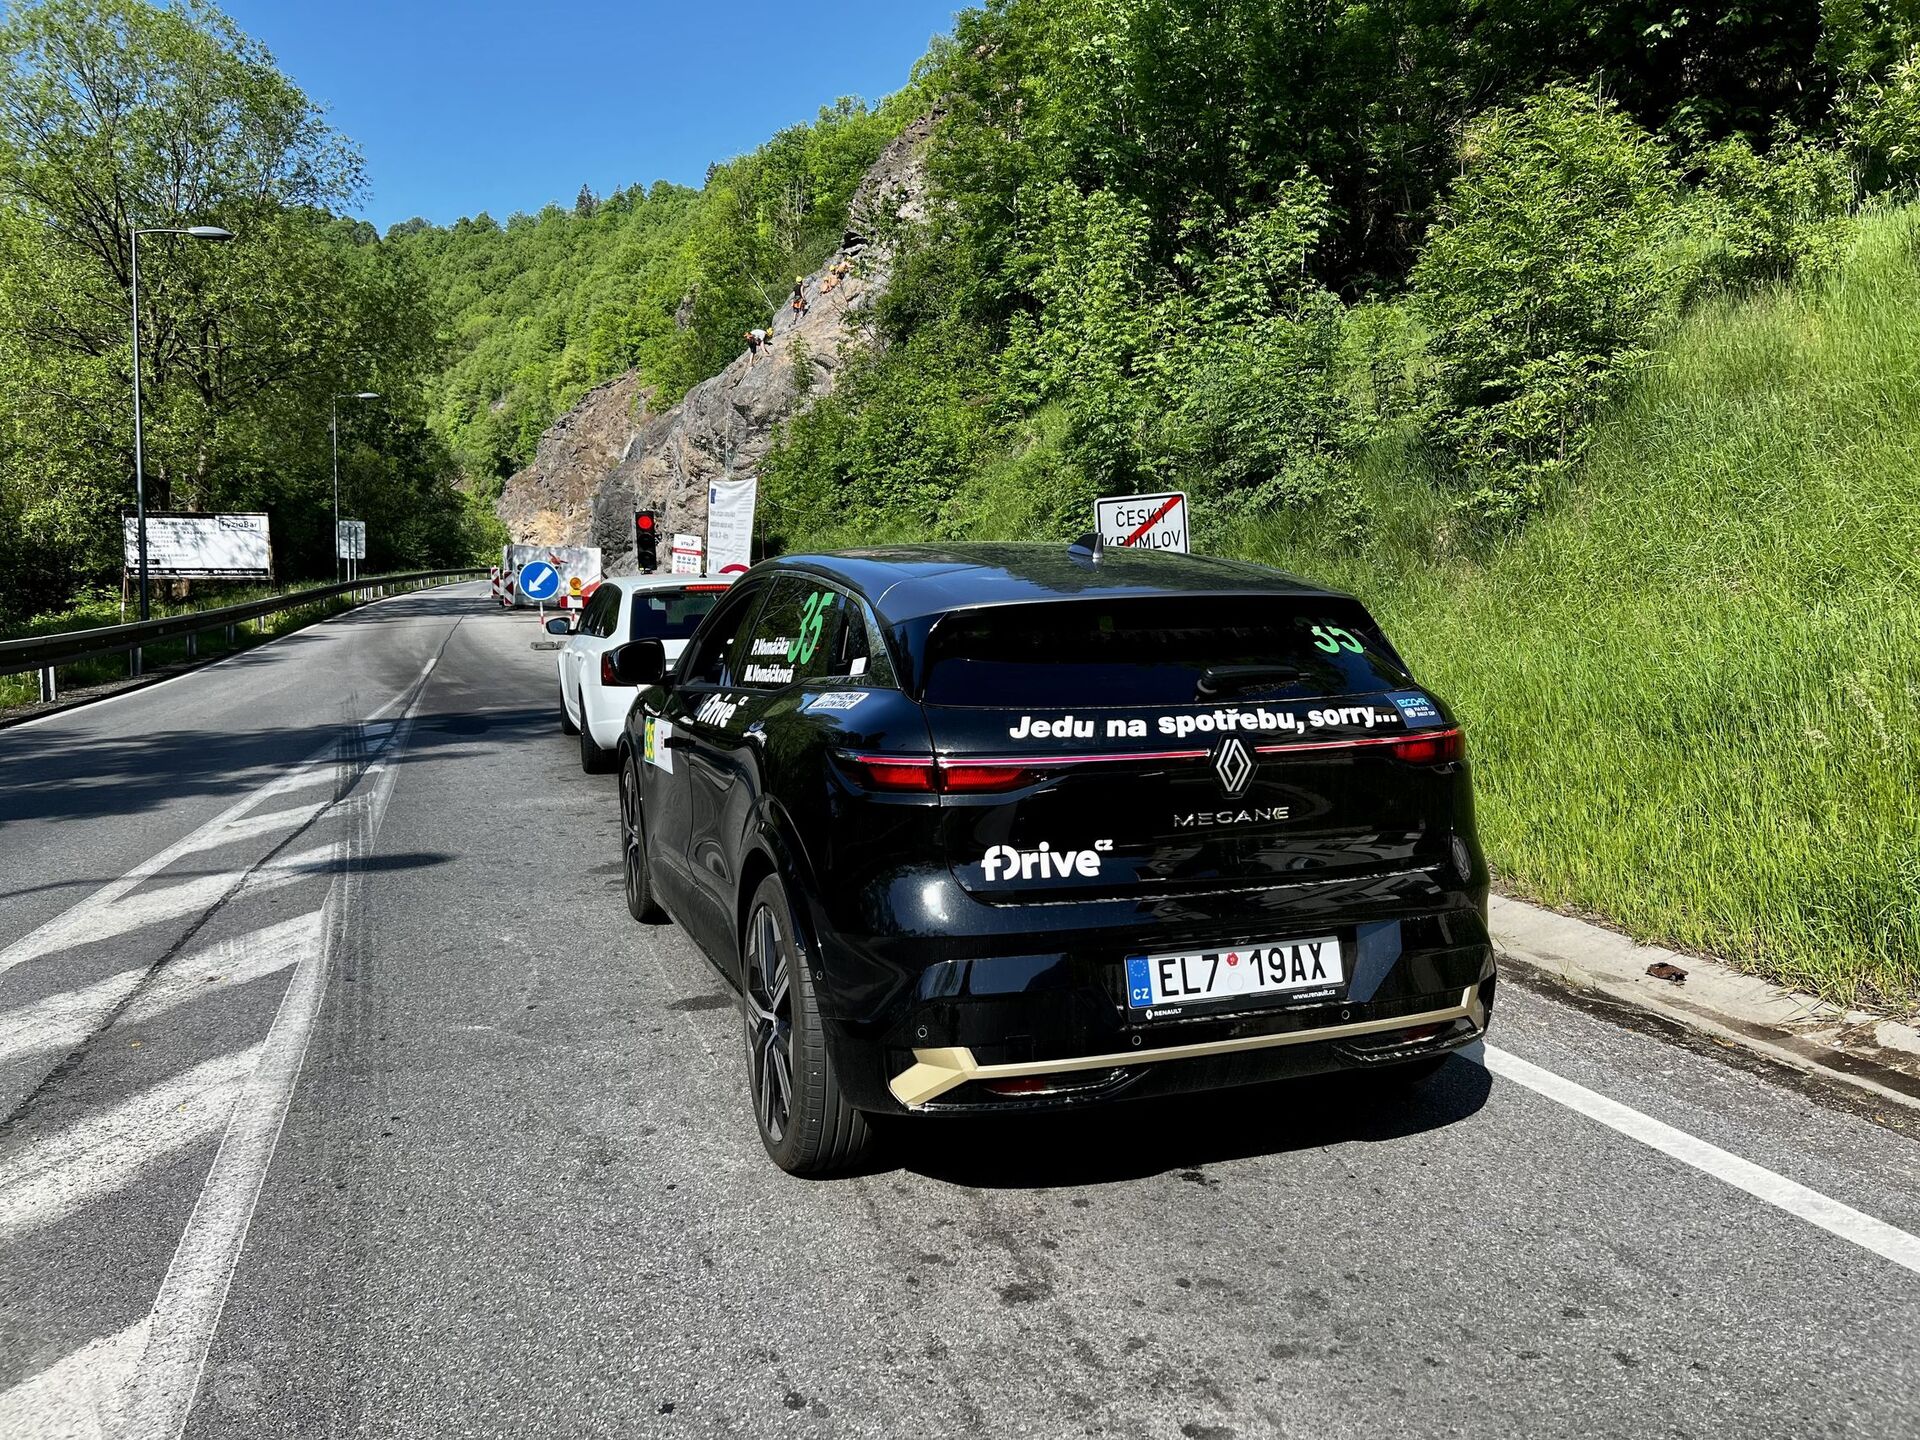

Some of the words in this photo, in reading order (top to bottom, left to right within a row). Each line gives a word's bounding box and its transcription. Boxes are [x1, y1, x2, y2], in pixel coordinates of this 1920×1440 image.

[1116, 502, 1167, 527] ČESKÝ
[787, 591, 836, 665] 35
[1009, 715, 1094, 739] Jedu
[1106, 718, 1147, 738] na
[1158, 707, 1305, 738] spotřebu,
[1309, 706, 1398, 728] sorry...
[1174, 806, 1289, 828] MEGANE
[1133, 987, 1150, 1000] CZ
[1158, 953, 1220, 997] EL7
[1249, 942, 1327, 986] 19AX
[1292, 989, 1336, 1000] www.renault.cz
[1153, 1007, 1182, 1017] RENAULT
